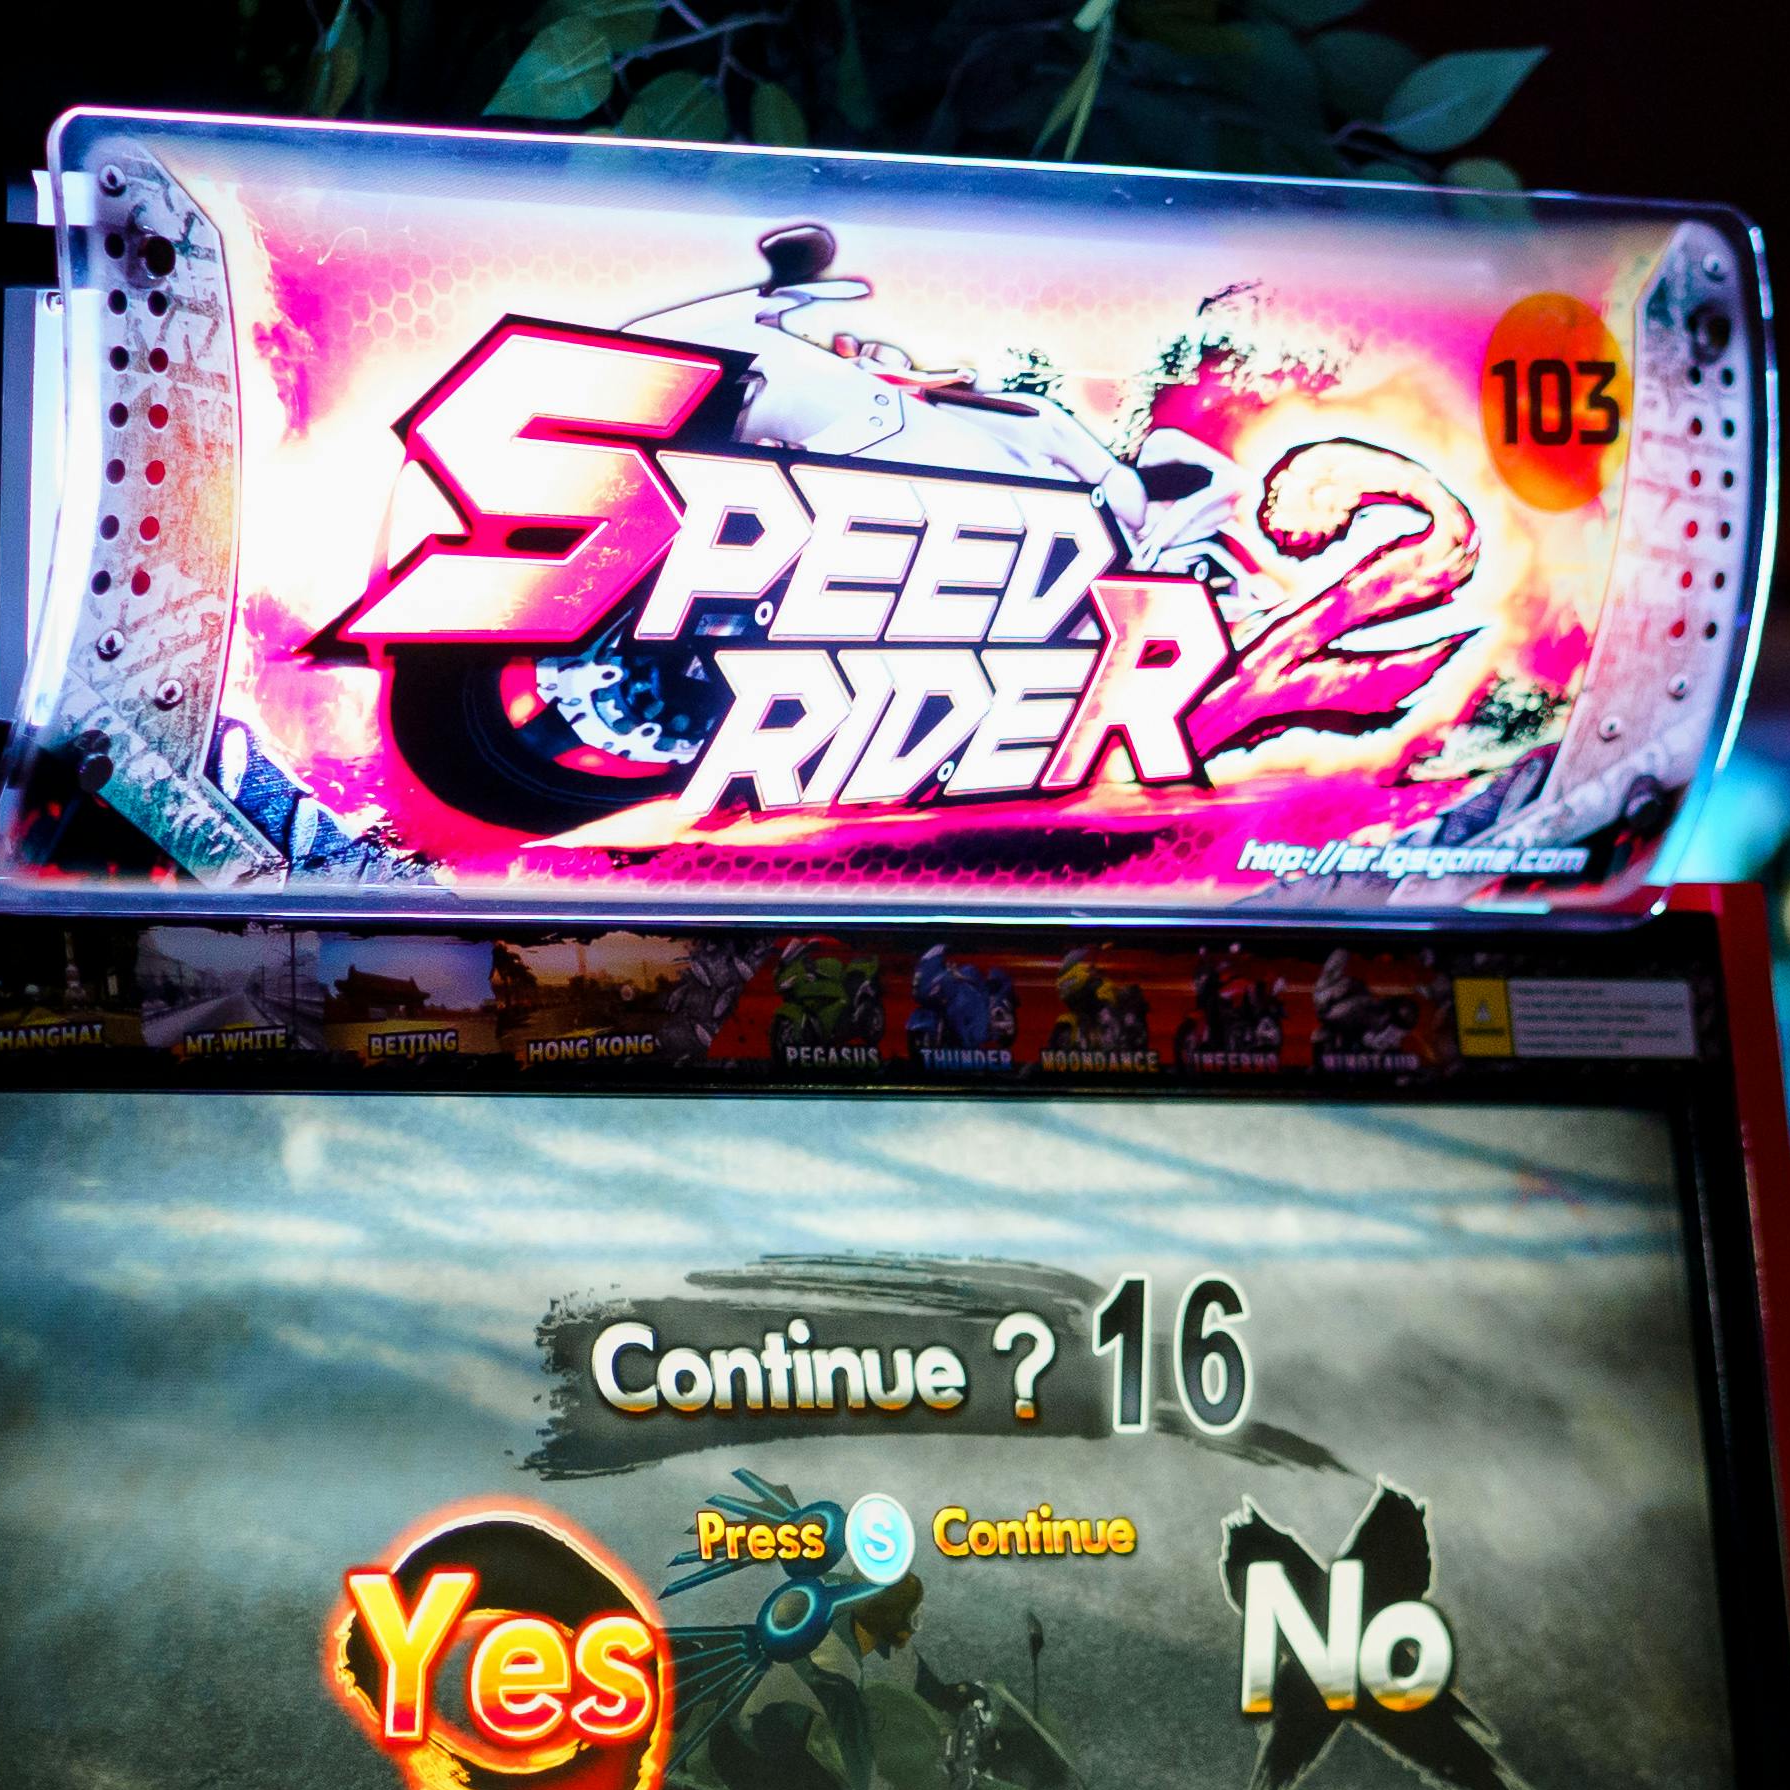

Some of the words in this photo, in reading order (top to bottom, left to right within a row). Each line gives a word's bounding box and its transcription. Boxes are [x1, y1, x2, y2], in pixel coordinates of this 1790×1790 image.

[1490, 358, 1620, 446] 103
[301, 312, 1123, 655] SPEED
[1195, 435, 1486, 765] 2
[679, 574, 1233, 814] RIDER
[368, 1030, 459, 1060] BEIJING
[527, 1036, 591, 1063] HONG
[594, 1033, 655, 1060] KONG
[785, 1045, 881, 1070] PEGASUS
[919, 1048, 1013, 1073] THUNDER
[1041, 1048, 1160, 1073] MOONDANCE
[590, 1315, 969, 1415] Continue
[992, 1311, 1058, 1420] ?
[1091, 1271, 1254, 1435] 16
[696, 1510, 826, 1562] Press
[931, 1503, 1138, 1557] Continue
[347, 1568, 658, 1742] Yes
[1241, 1558, 1455, 1714] No
